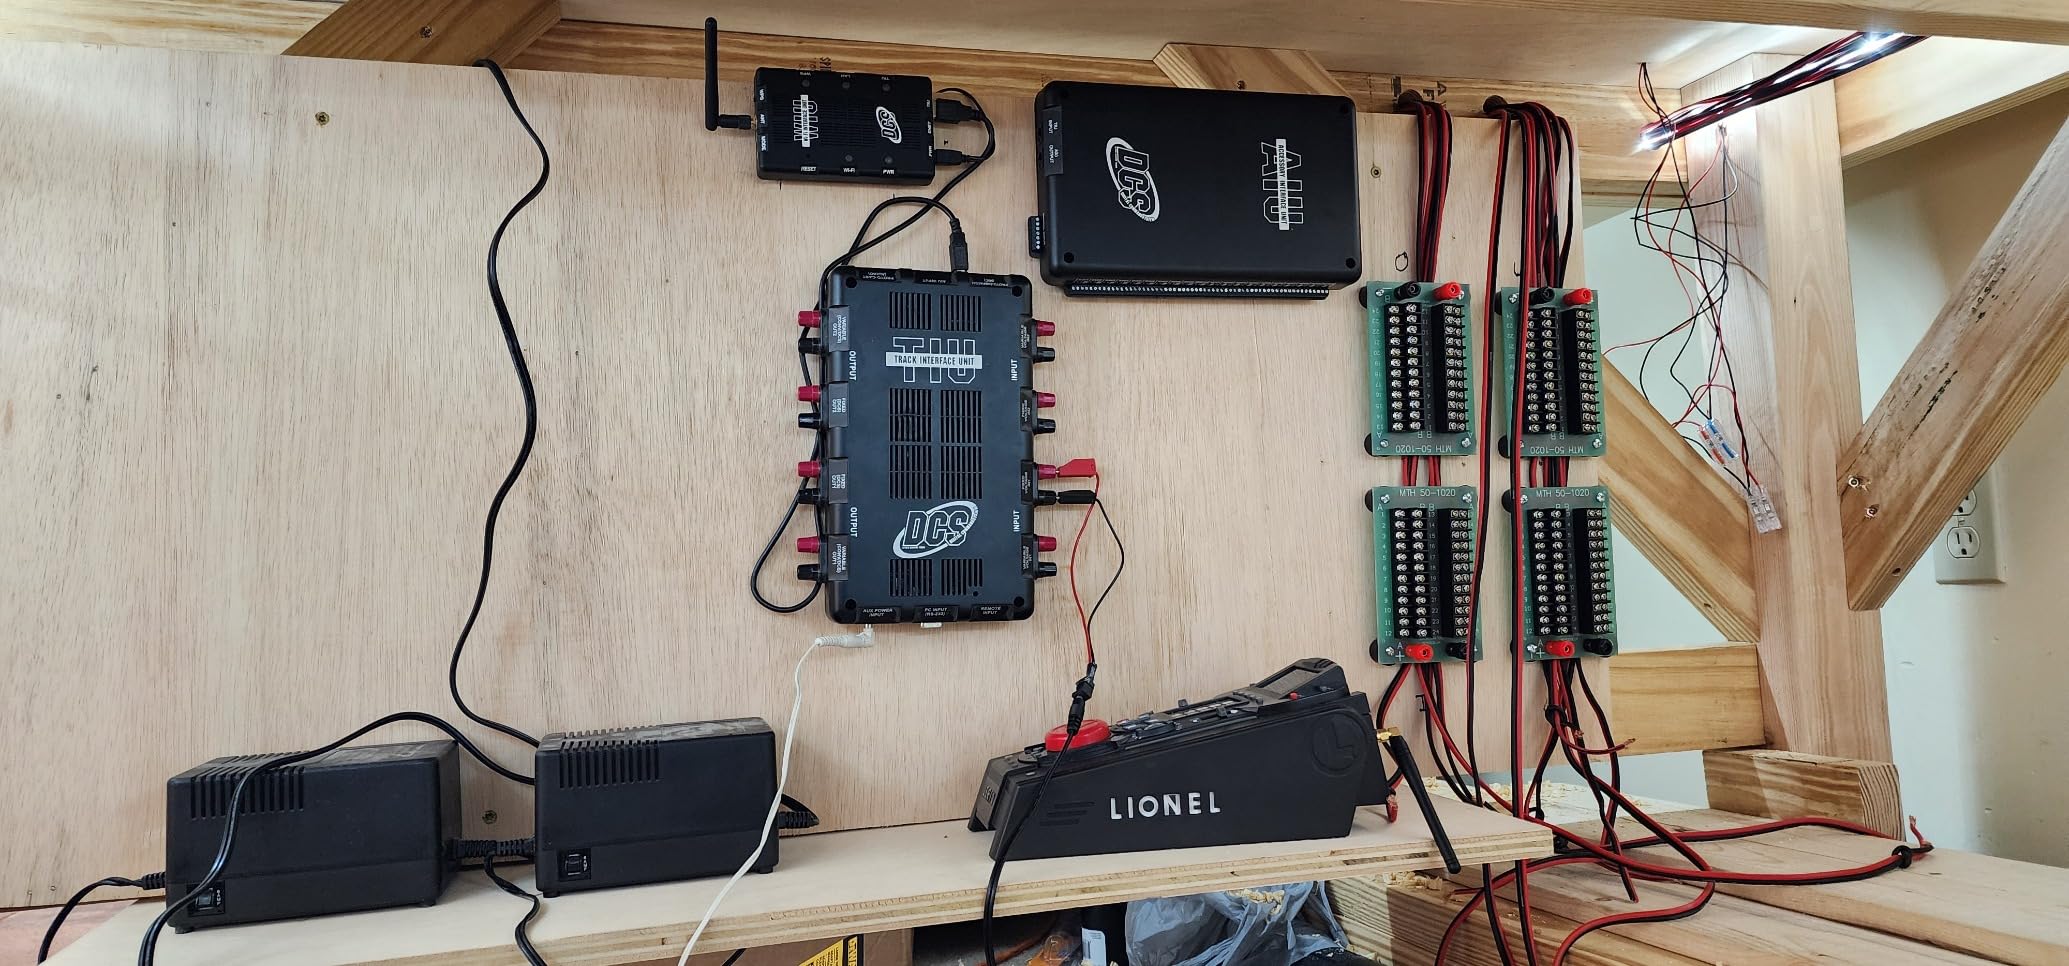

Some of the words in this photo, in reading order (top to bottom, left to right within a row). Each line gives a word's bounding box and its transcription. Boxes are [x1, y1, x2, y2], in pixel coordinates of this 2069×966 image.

[1278, 144, 1286, 177] ACCESSORY
[1261, 141, 1304, 224] AIU
[1279, 180, 1287, 209] INTERFACE
[849, 350, 857, 381] OUTPUT
[893, 336, 975, 384] TIU
[894, 354, 917, 365] TRACK
[919, 355, 956, 366] INTERFACE
[958, 356, 975, 366] UNIT
[1010, 358, 1018, 381] INPUT
[1395, 444, 1432, 453] 50-1020
[1436, 444, 1452, 453] MTH
[1530, 446, 1565, 454] 50-1020
[1568, 445, 1584, 454] MTH
[1399, 488, 1416, 497] MTH
[1420, 488, 1456, 497] 50-1020
[1535, 489, 1552, 497] MTH
[1555, 489, 1590, 497] 50-1020
[903, 510, 969, 547] DCS
[1012, 510, 1020, 532] INPUT
[1109, 791, 1222, 821] LIONEL
